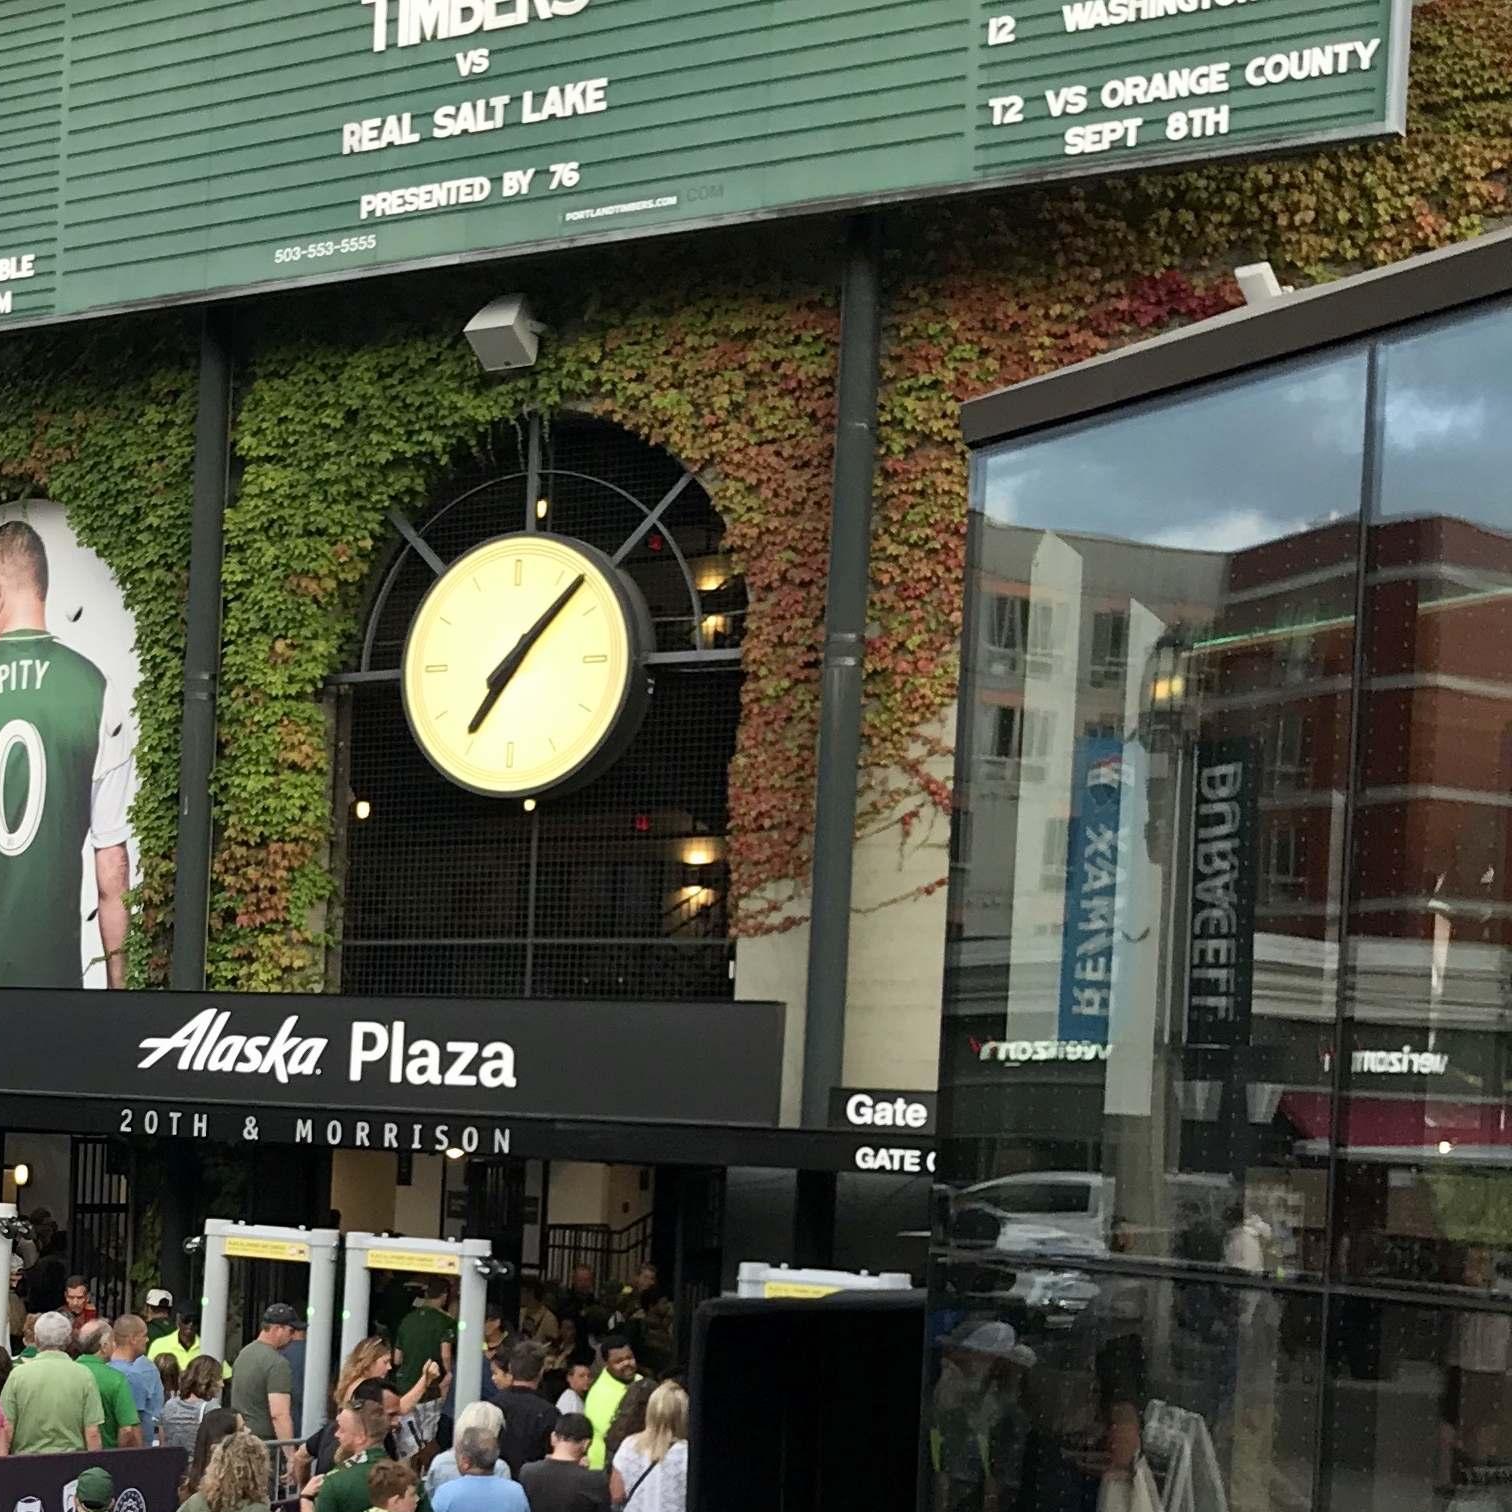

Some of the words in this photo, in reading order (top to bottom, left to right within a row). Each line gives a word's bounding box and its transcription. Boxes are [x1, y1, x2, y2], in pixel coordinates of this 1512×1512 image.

[456, 48, 489, 76] VS
[989, 95, 1024, 125] T2
[1045, 86, 1087, 117] VS
[1100, 63, 1230, 108] ORANGE
[1245, 38, 1380, 86] COUNTY
[342, 113, 420, 155] REAL
[432, 95, 511, 138] SALT
[521, 77, 608, 124] LAKE
[1064, 117, 1143, 155] SEPT
[1165, 105, 1230, 141] 8TH
[360, 175, 491, 220] PRESENTED
[502, 168, 535, 197] BY
[549, 162, 580, 190] 76
[565, 196, 677, 221] PORTLANDTIMBERS.COM
[274, 235, 376, 263] 503-553-5555
[136, 1008, 328, 1083] Alaska
[349, 1020, 517, 1088] Plaza
[120, 1109, 207, 1137] 20TH
[243, 1116, 259, 1141] &
[296, 1119, 510, 1154] MORRISON
[846, 1094, 927, 1127] Gate
[855, 1146, 921, 1172] GATE
